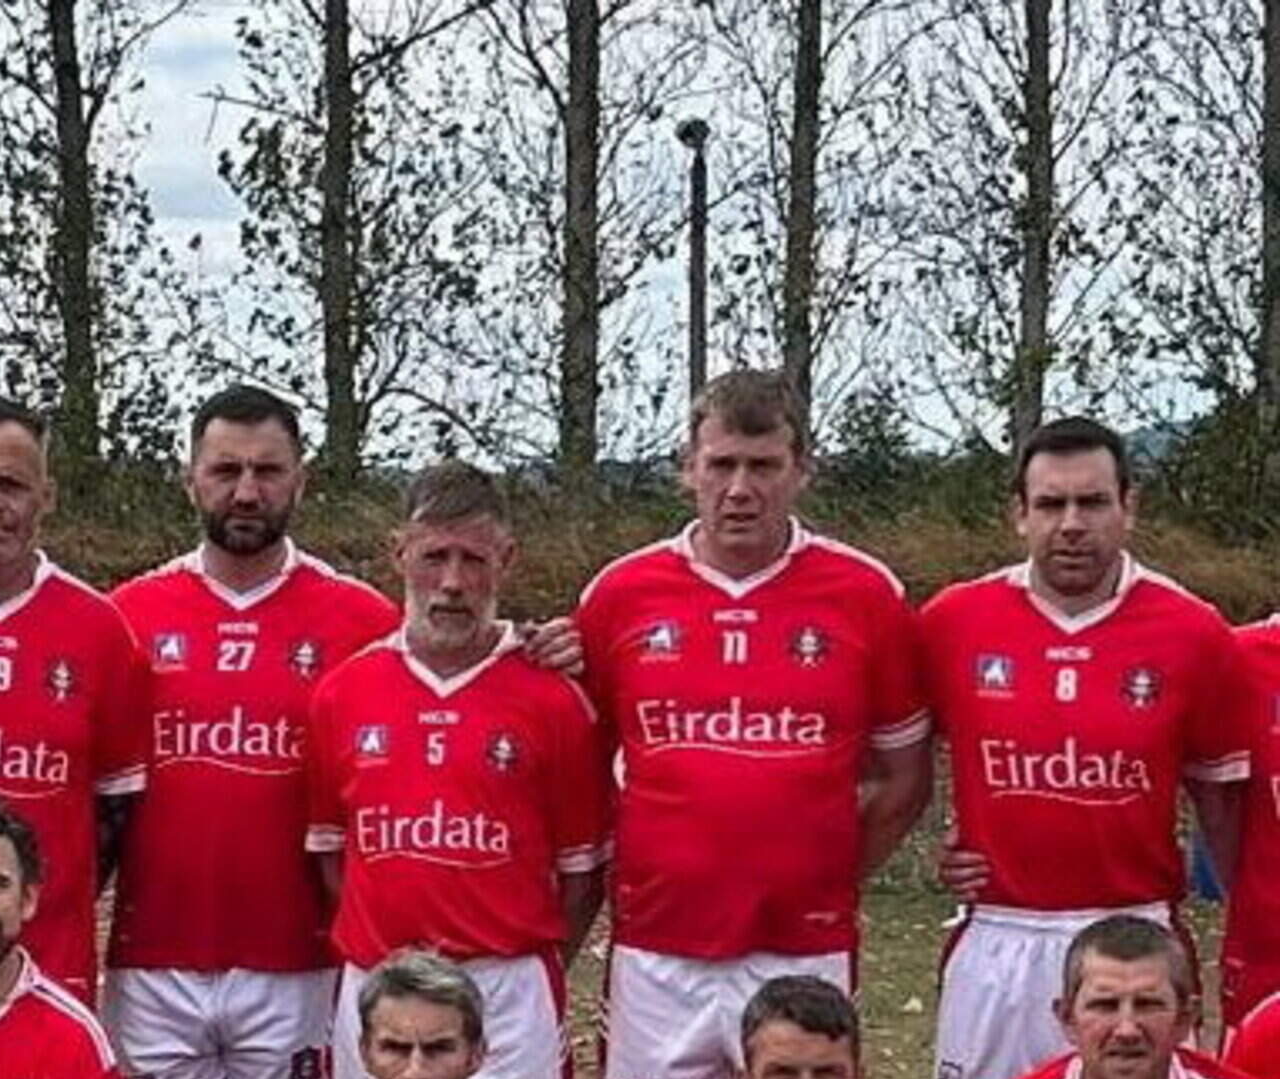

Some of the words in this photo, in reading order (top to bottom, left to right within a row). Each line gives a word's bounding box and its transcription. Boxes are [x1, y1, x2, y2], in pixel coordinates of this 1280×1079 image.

[217, 640, 256, 672] 27
[722, 630, 748, 663] 11
[1055, 667, 1078, 702] 8
[637, 695, 826, 744] Eirdata
[426, 731, 445, 766] 5
[980, 736, 1151, 791] Eirdata
[356, 799, 510, 853] Eirdata
